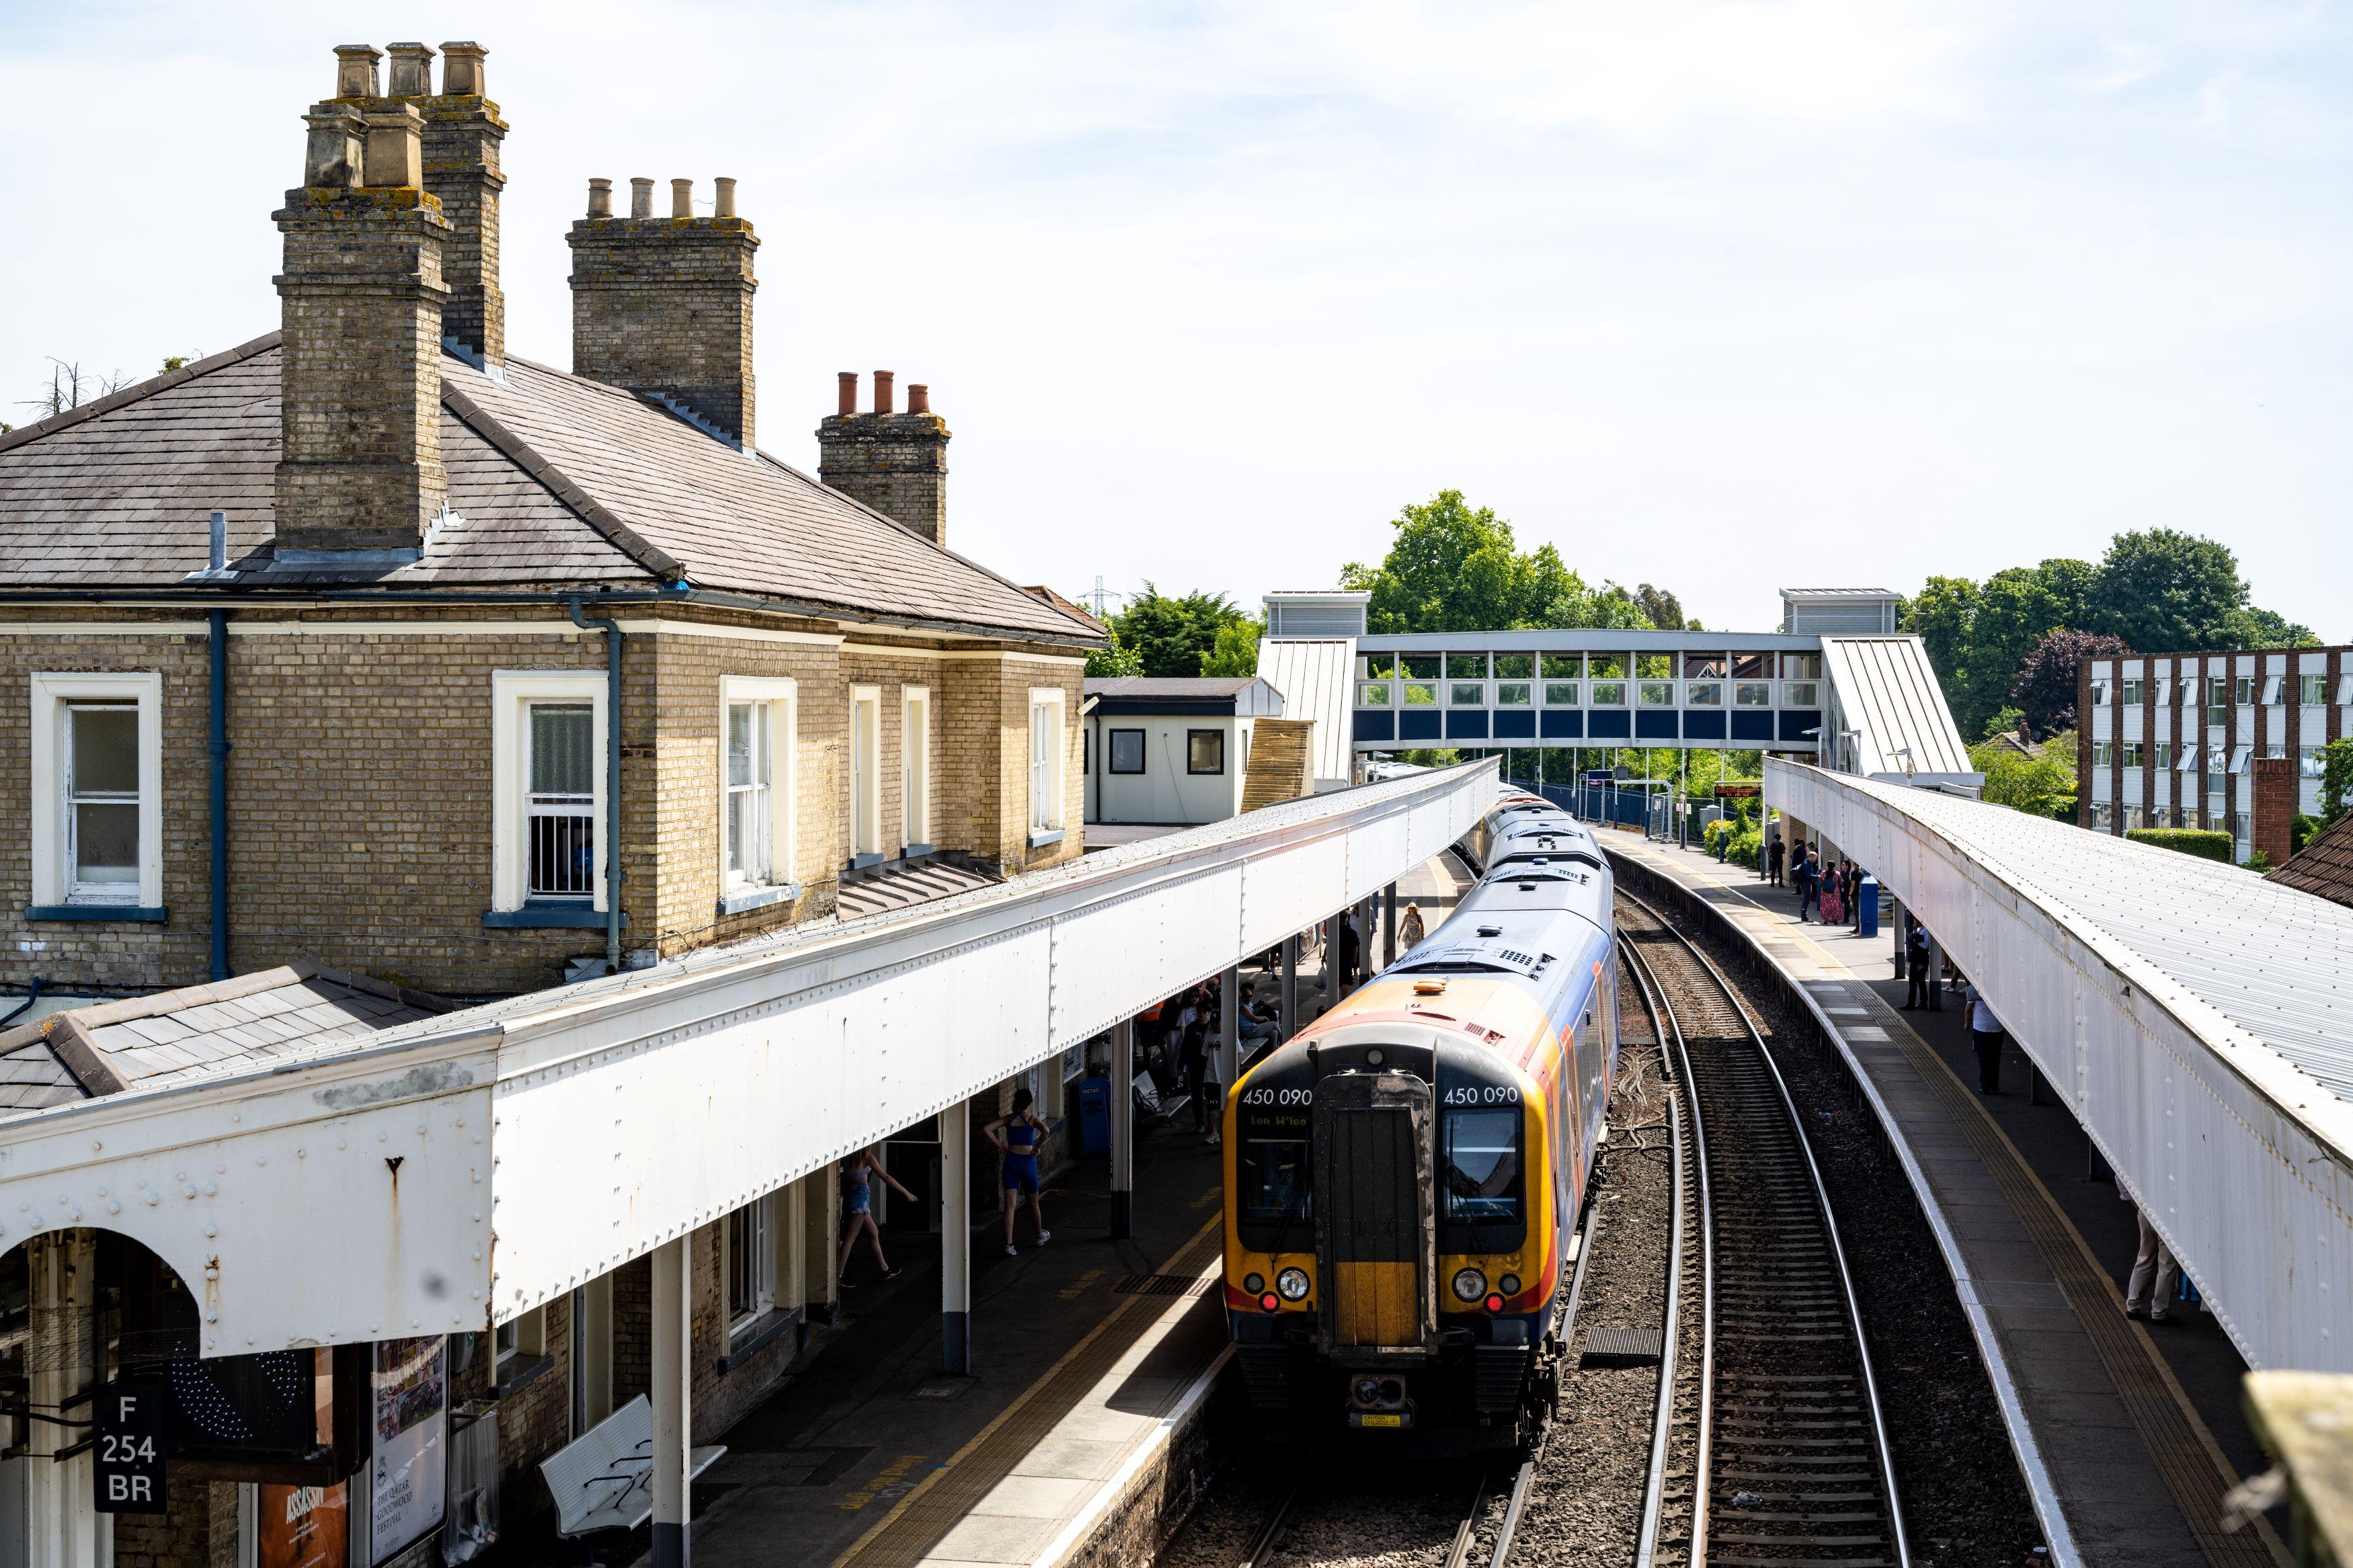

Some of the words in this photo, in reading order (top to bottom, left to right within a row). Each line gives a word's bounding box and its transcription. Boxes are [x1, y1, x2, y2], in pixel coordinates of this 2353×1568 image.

[1243, 1089, 1274, 1104] 450
[1279, 1089, 1312, 1106] 090
[1443, 1087, 1478, 1104] 450
[1484, 1087, 1518, 1102] 090
[1251, 1116, 1269, 1124] Lon
[120, 1397, 136, 1422] F
[102, 1435, 156, 1463] 254
[109, 1475, 151, 1501] BR
[376, 1493, 388, 1507] THE
[389, 1479, 409, 1499] QATAR
[286, 1487, 323, 1525] ASSASSIN
[377, 1491, 413, 1521] GOODWOOD
[377, 1512, 401, 1536] FESTIVAL
